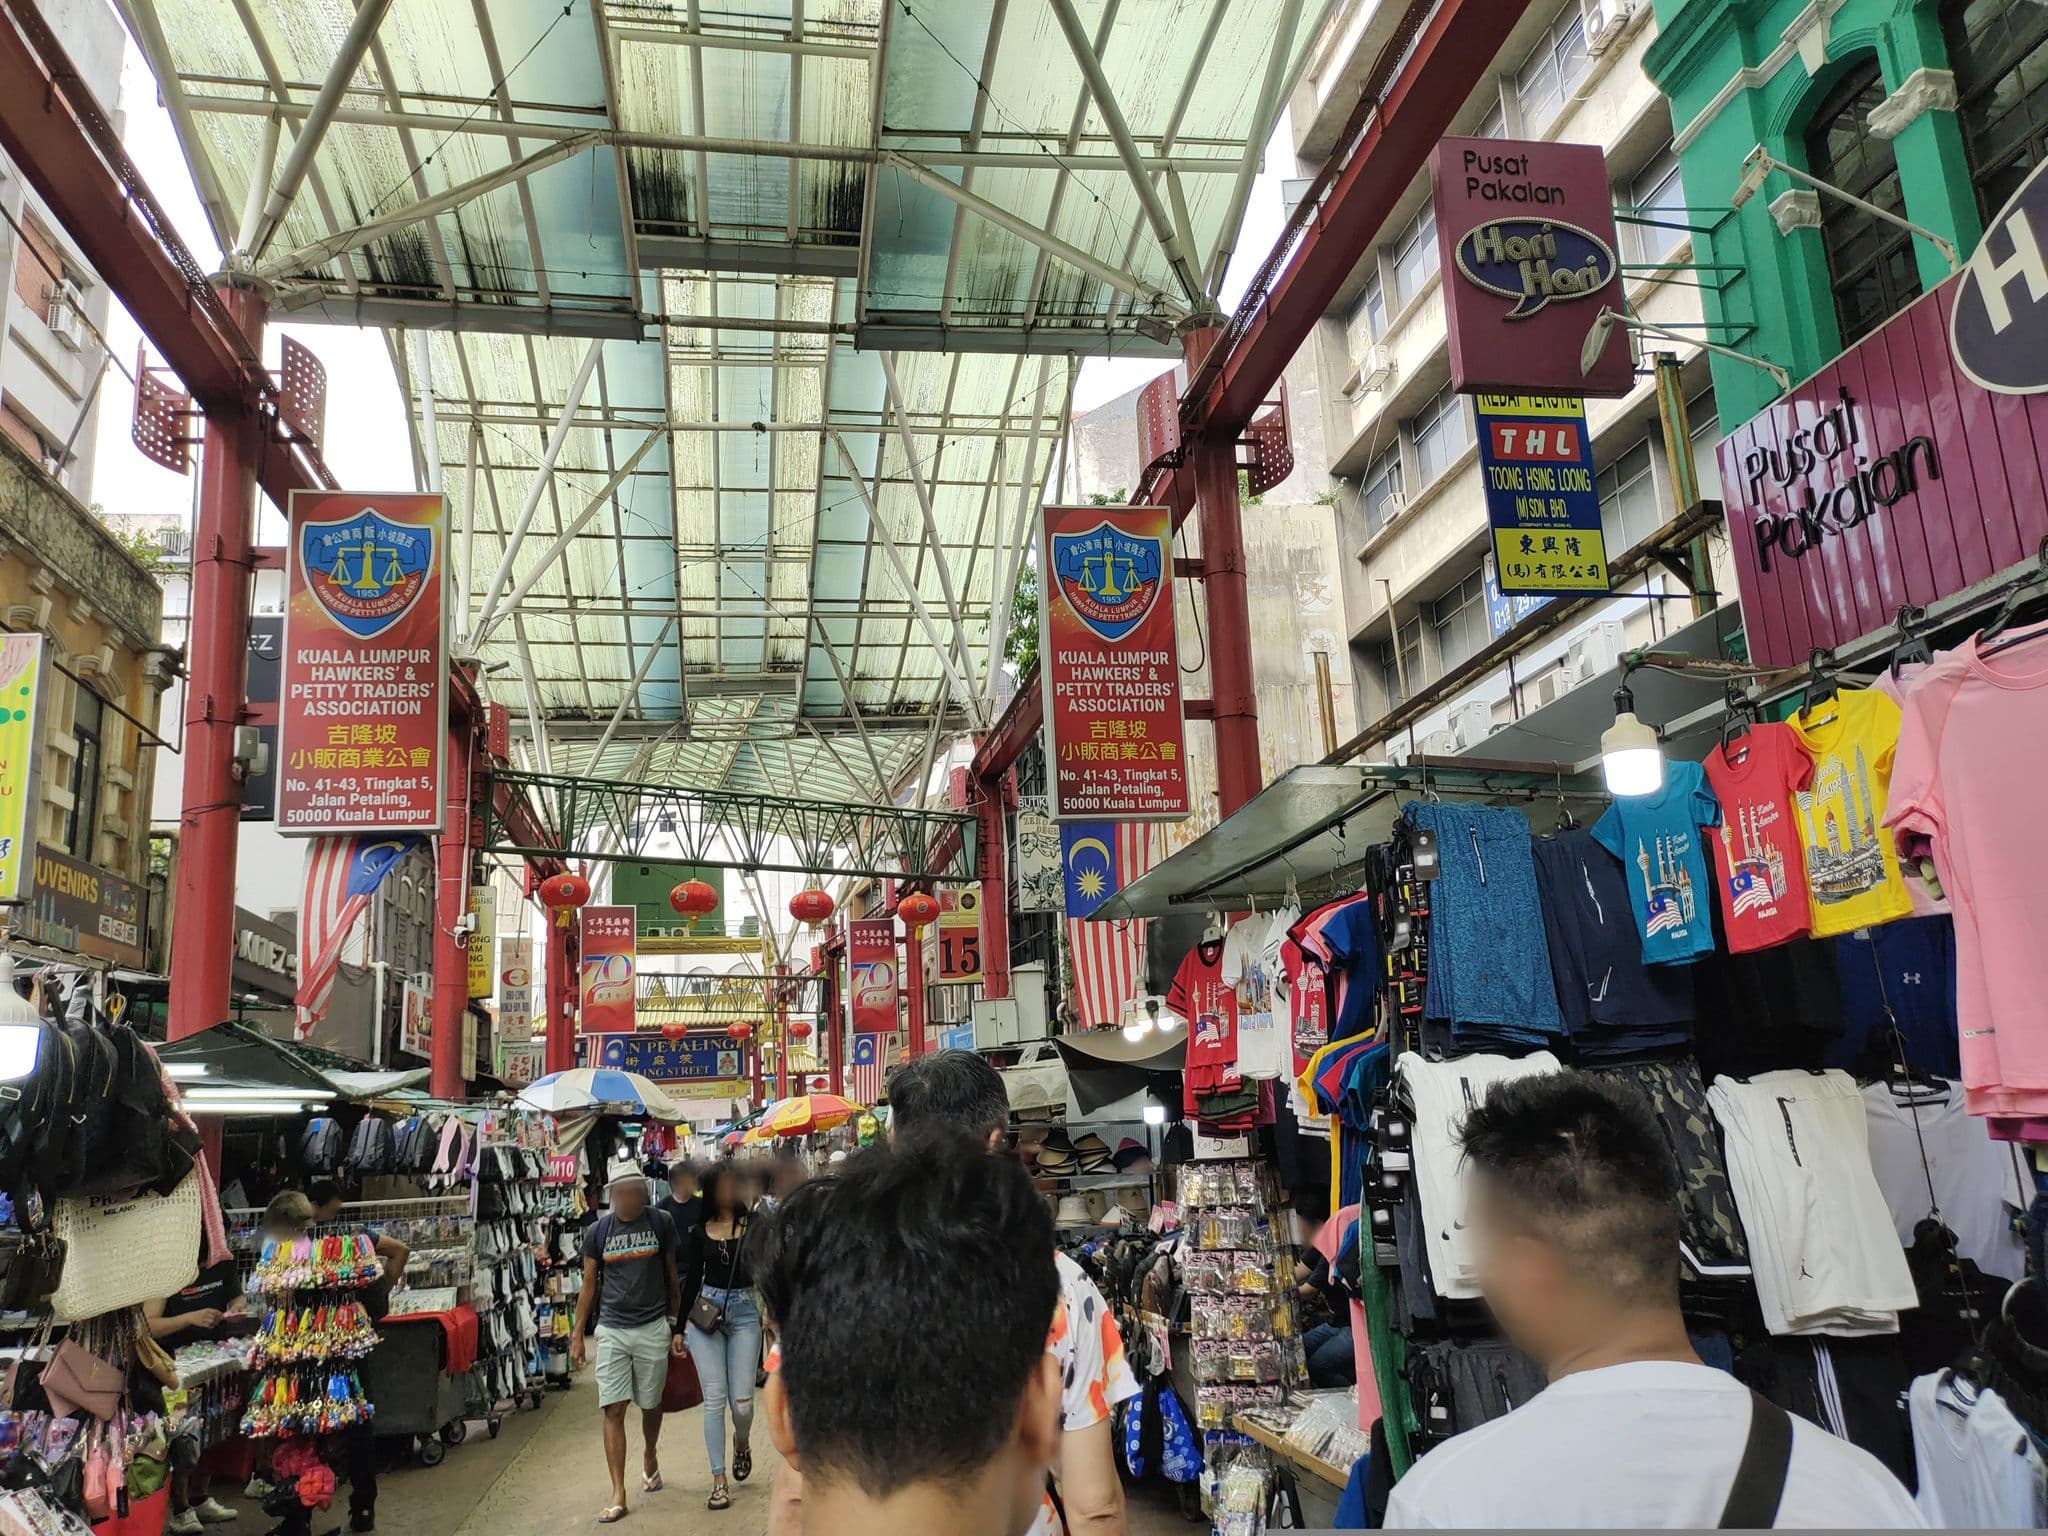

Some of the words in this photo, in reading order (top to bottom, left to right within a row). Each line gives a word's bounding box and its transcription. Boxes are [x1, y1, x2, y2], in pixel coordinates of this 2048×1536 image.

[1463, 150, 1528, 176] Pusat
[1473, 223, 1557, 263] Hari
[1519, 255, 1601, 297] Hari
[1743, 385, 1860, 505] Pusat
[1489, 467, 1524, 491] TOONG
[1526, 467, 1556, 492] HSING
[1558, 468, 1592, 492] LOONG
[1550, 498, 1569, 518] BHD.
[1520, 534, 1582, 557] 東興隆
[336, 591, 363, 608] KUALA
[366, 593, 400, 609] LUMPUR
[356, 589, 380, 598] 1953
[1102, 596, 1121, 604] 1953
[350, 609, 377, 617] PETTY
[1086, 597, 1108, 613] KUALA
[1111, 598, 1139, 613] LUMPUR
[297, 649, 354, 664] KUALA
[360, 649, 430, 664] LUMPUR
[1058, 651, 1106, 665] KUALA
[1110, 652, 1169, 665] LUMPUR
[311, 666, 400, 681] HAWKERS'
[404, 667, 416, 680] &
[1071, 667, 1144, 681] HAWKERS'
[1149, 668, 1158, 680] &
[291, 683, 347, 698] PETTY
[1056, 683, 1102, 696] PETTY
[304, 700, 421, 716] ASSOCIATION
[1068, 698, 1165, 712] ASSOCIATION
[328, 724, 397, 745] 吉隆坡
[1089, 720, 1147, 739] 吉隆坡
[290, 747, 431, 769] 小販商業公會
[1061, 741, 1177, 761] 小販商業公會
[1060, 770, 1080, 781] No.
[1084, 770, 1121, 783] 41-43,
[1124, 768, 1167, 783] Tingkat
[1171, 769, 1182, 782] 5,
[286, 779, 310, 792] No.
[315, 778, 361, 793] 41-43,
[364, 777, 417, 793] Tingkat
[421, 777, 433, 791] 5,
[1079, 784, 1110, 795] Jalan
[1114, 783, 1164, 797] Petaling,
[307, 793, 346, 807] Jalan
[350, 792, 411, 807] Petaling,
[1063, 798, 1100, 810] 50000
[1103, 797, 1135, 809] Kuala
[1139, 797, 1182, 810] Lumpur
[287, 809, 331, 823] 50000
[336, 808, 375, 822] Kuala
[379, 808, 431, 823] Lumpur
[37, 856, 98, 904] UVENIRS
[469, 936, 491, 944] ONG
[469, 954, 484, 962] NG
[939, 937, 980, 974] 15
[584, 954, 632, 983] 70
[853, 963, 894, 989] 70
[667, 1065, 711, 1077] STREET
[550, 1161, 574, 1177] M10
